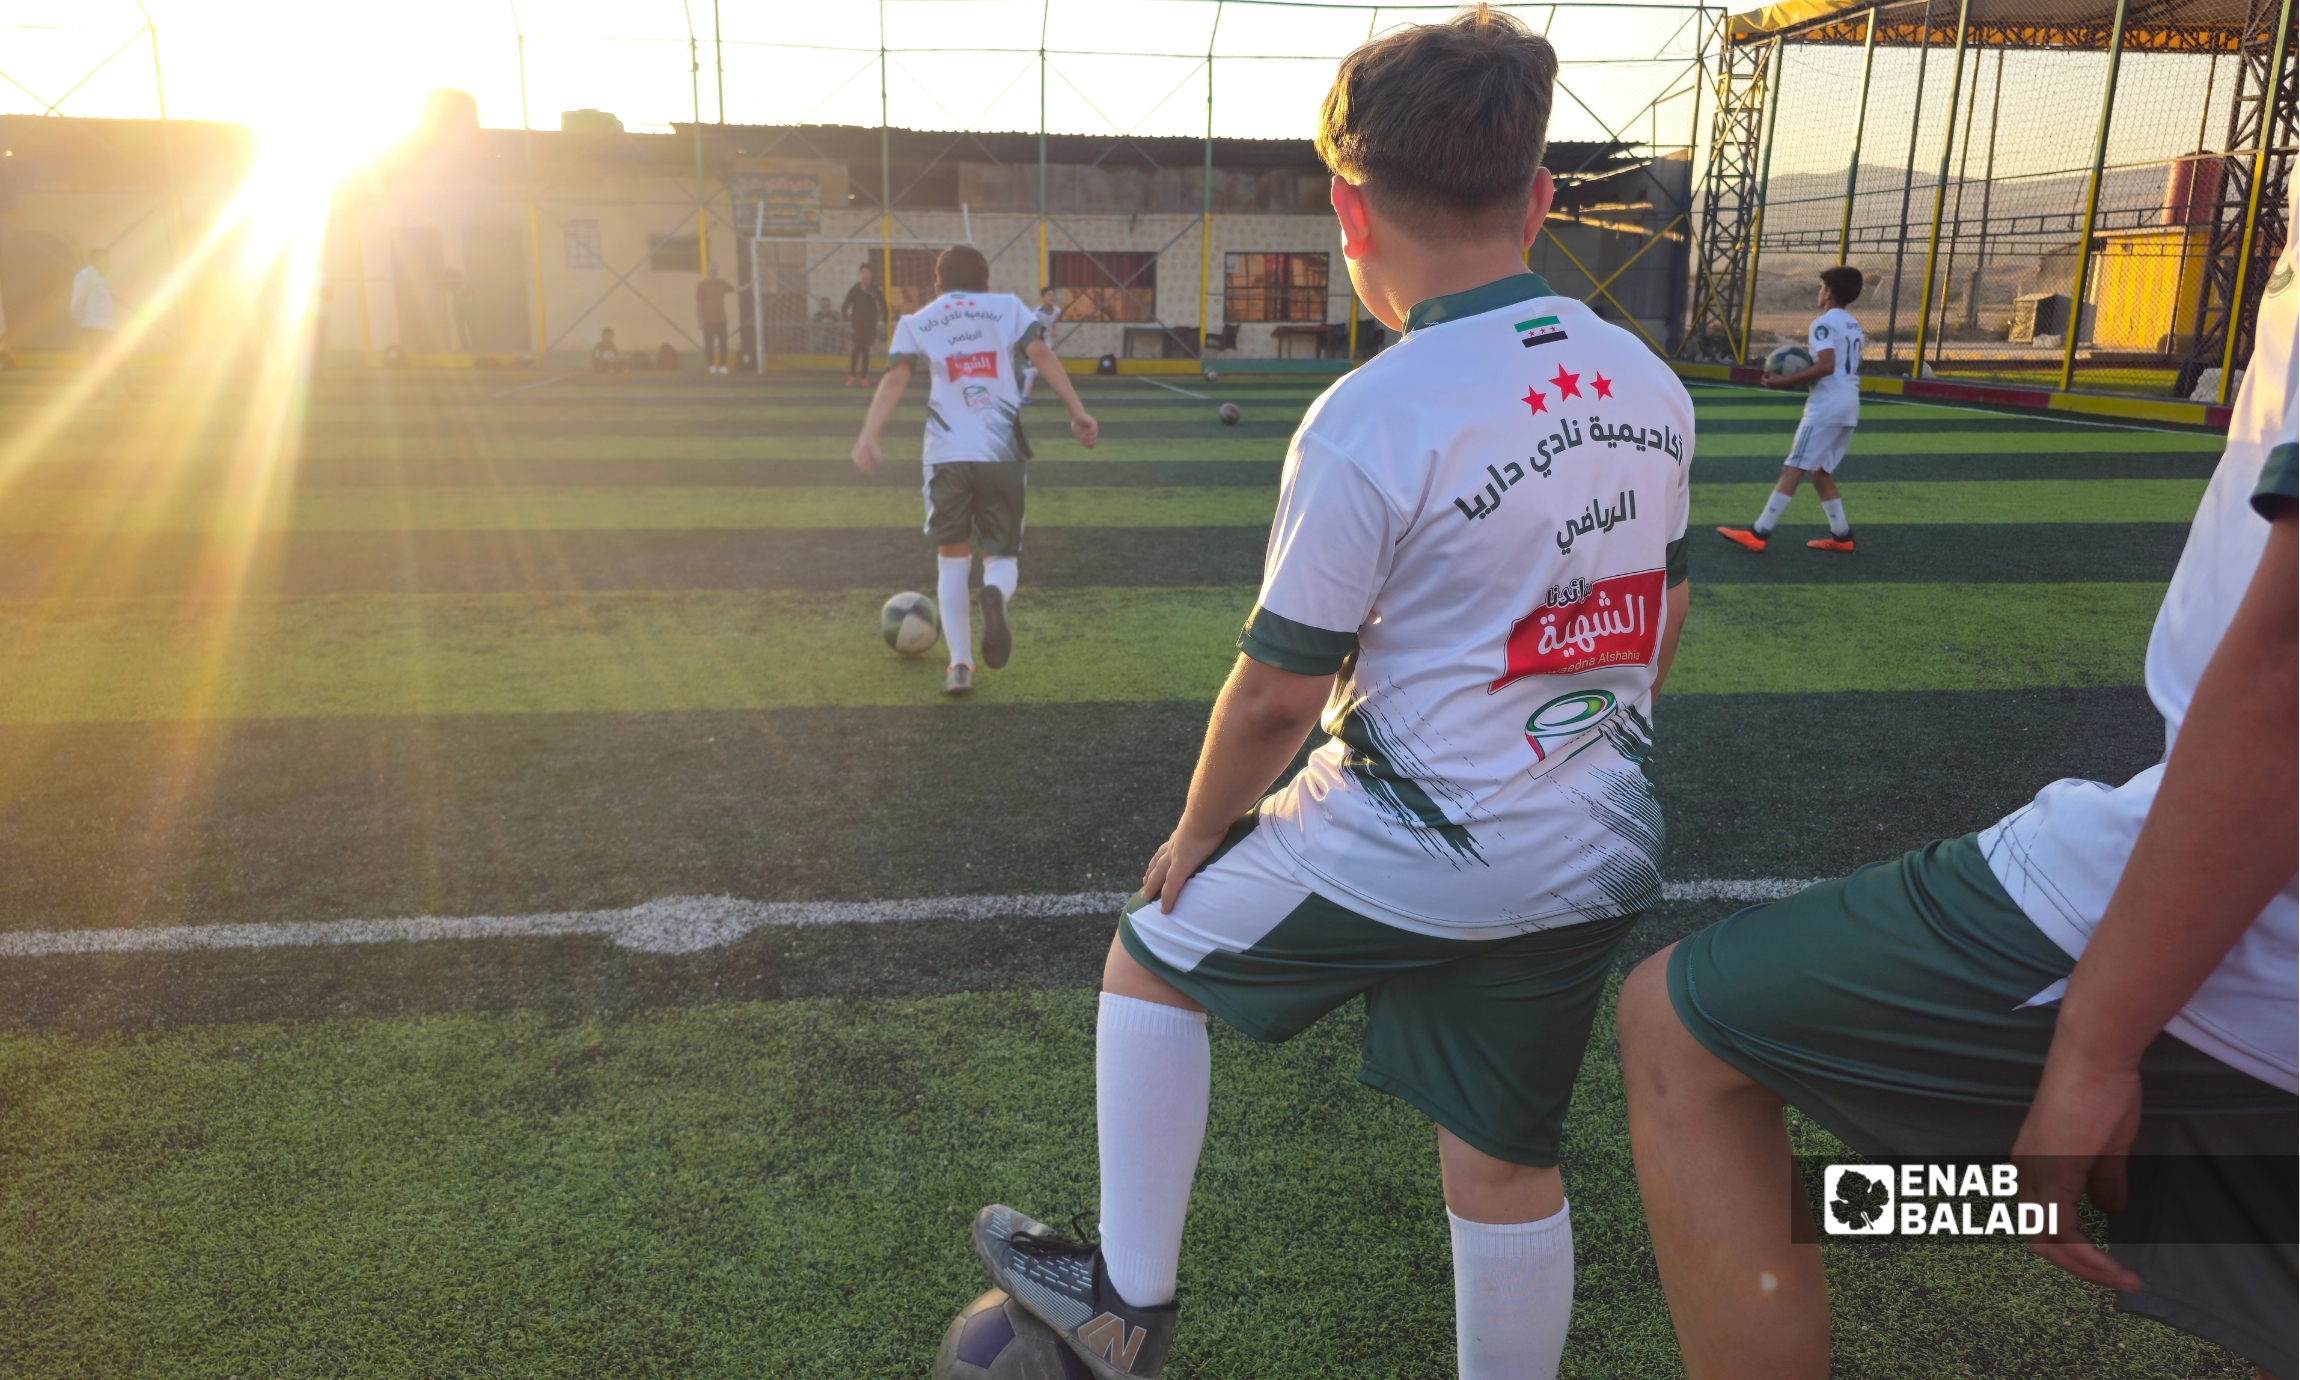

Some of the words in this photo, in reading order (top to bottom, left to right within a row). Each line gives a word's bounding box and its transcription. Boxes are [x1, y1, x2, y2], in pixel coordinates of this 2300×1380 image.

[1530, 418, 1583, 478] نادي
[1589, 416, 1683, 467] أكاديمية
[1454, 462, 1525, 521] داريا
[1556, 490, 1636, 555] الرياضي
[1538, 590, 1645, 658] الشهية
[1598, 650, 1641, 664] Alshahia
